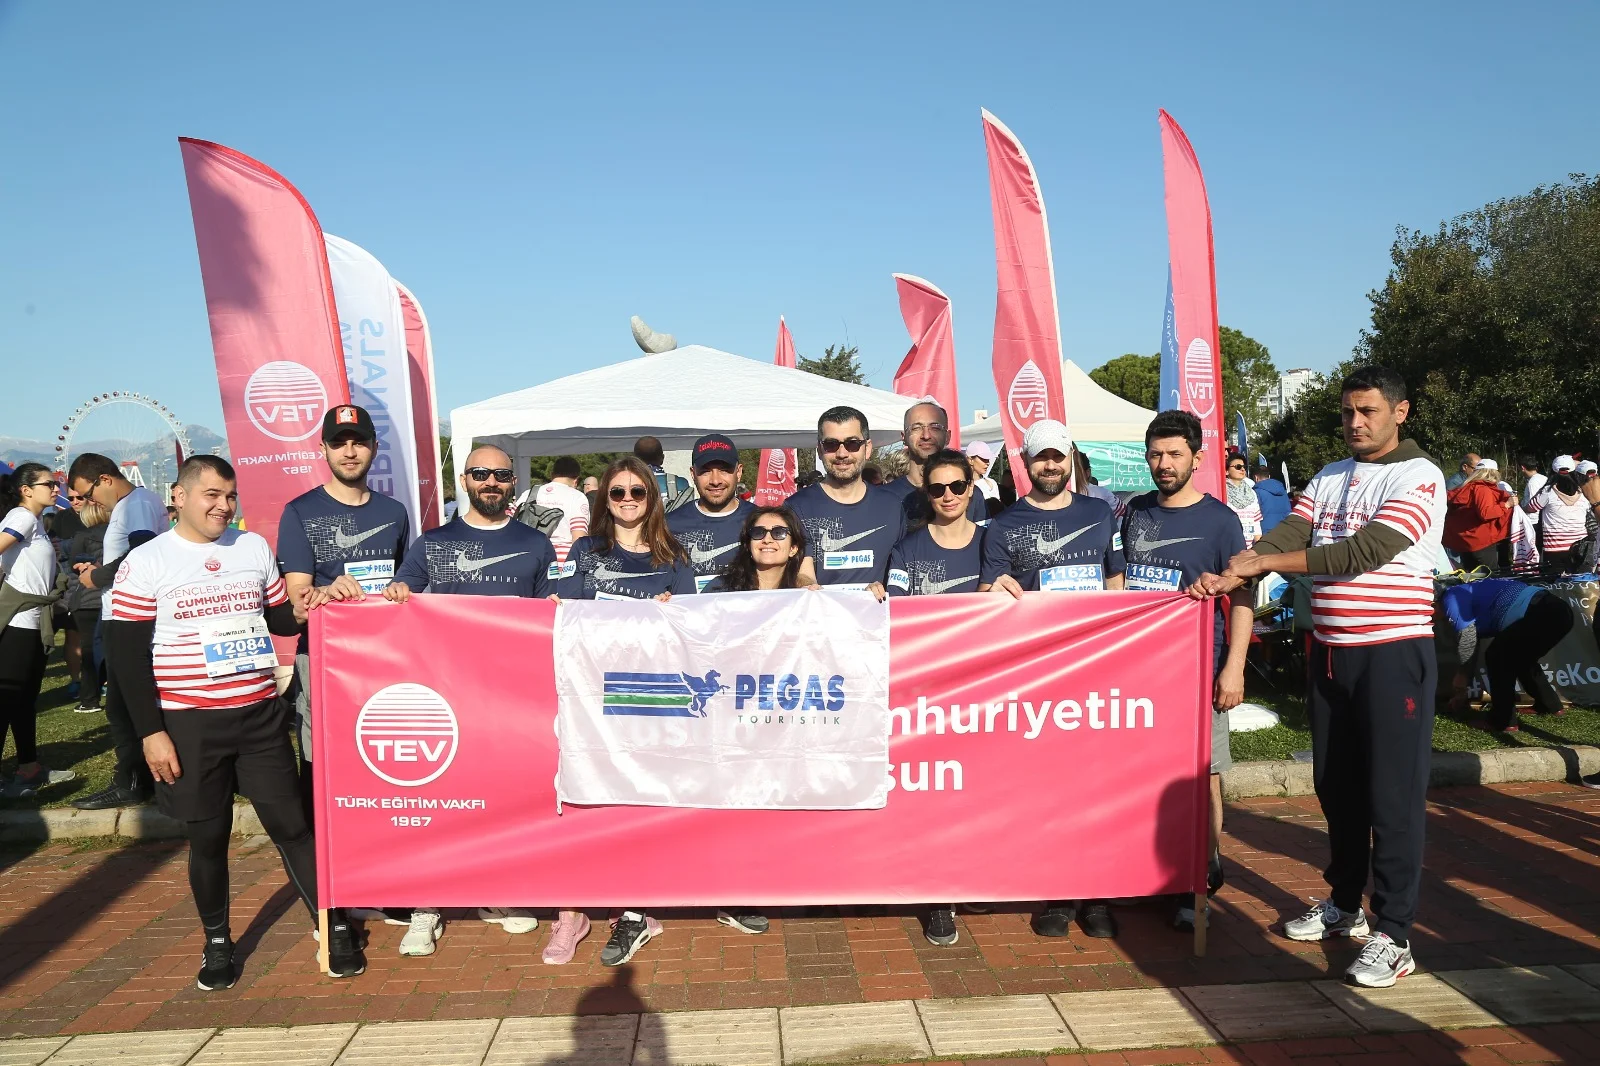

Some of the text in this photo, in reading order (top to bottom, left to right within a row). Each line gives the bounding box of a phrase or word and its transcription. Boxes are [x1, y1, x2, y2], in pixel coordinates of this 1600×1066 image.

[1117, 463, 1150, 475] ÇEÇE
[851, 554, 870, 563] PEGAS
[374, 564, 392, 572] PEGAS
[1047, 566, 1096, 580] 11628
[1131, 564, 1172, 580] 11631
[890, 573, 909, 585] PEGAS
[166, 585, 221, 600] GENÇLER
[374, 584, 387, 592] PEG
[176, 590, 260, 609] CUMHURİYETİN
[173, 602, 231, 620] GELECEĞİ
[212, 637, 267, 656] 12084
[735, 673, 845, 712] PEGAS
[738, 715, 840, 725] TOURISTIK
[368, 739, 447, 762] TEV
[335, 796, 486, 810] TÜRK EĞİTİM VAKFI
[390, 816, 432, 827] 1967
